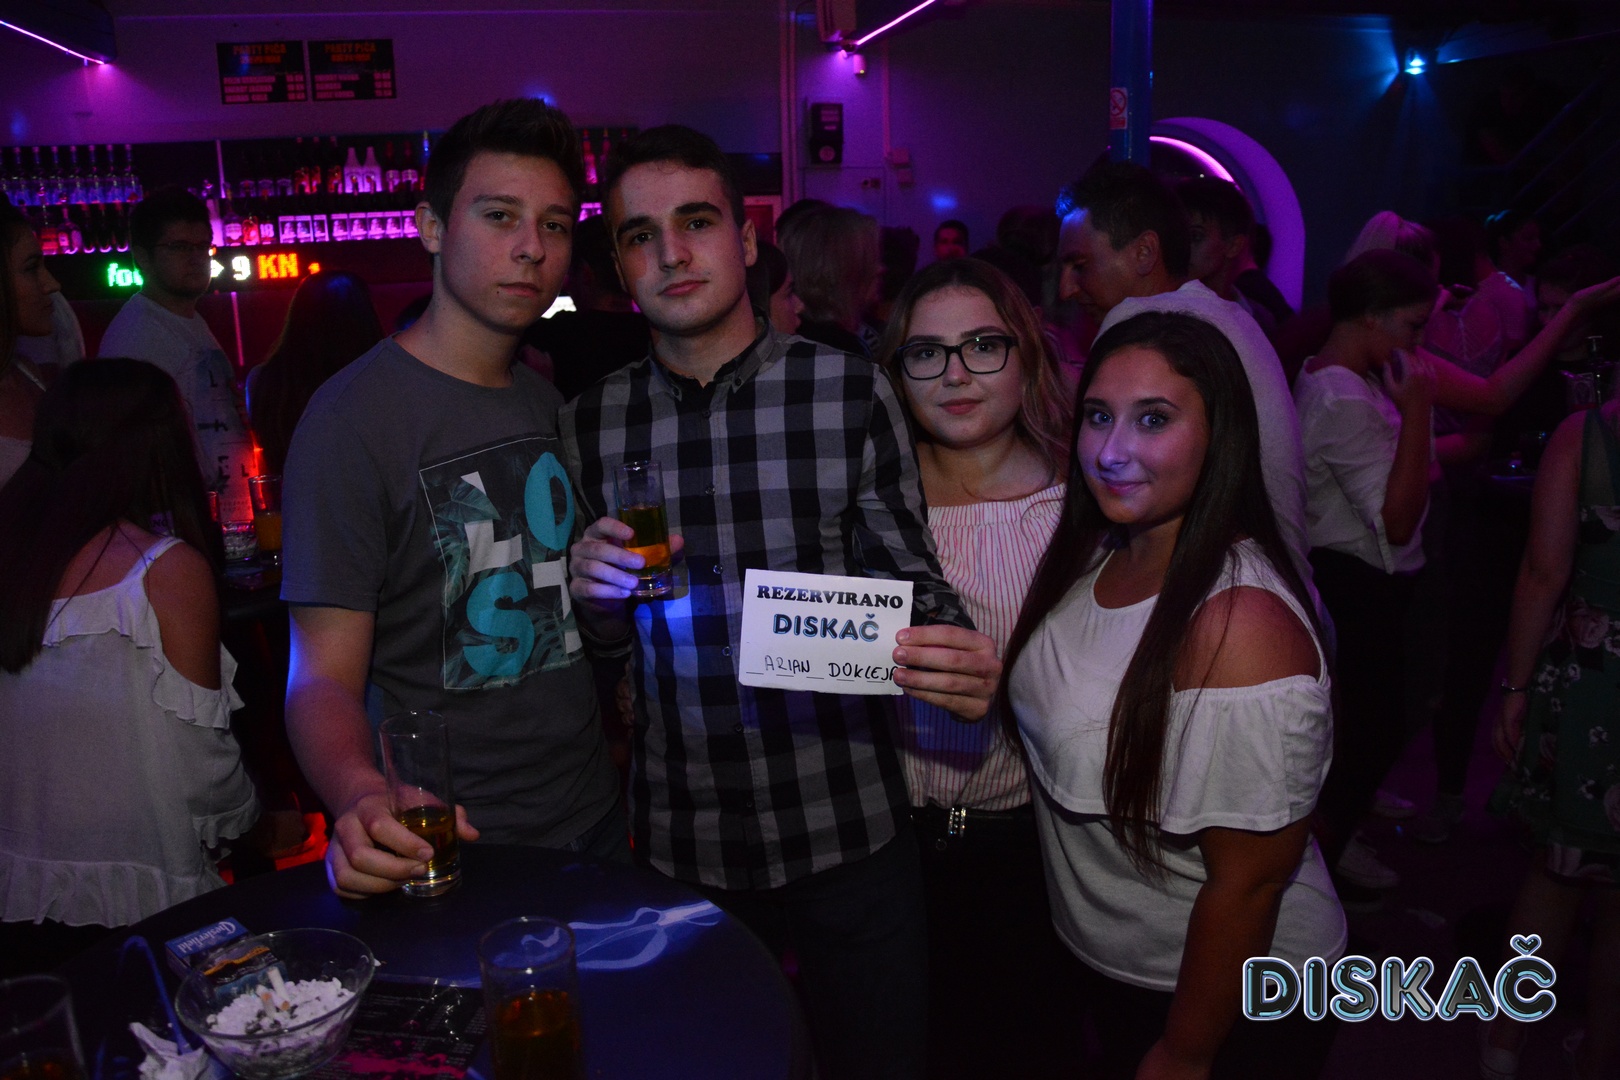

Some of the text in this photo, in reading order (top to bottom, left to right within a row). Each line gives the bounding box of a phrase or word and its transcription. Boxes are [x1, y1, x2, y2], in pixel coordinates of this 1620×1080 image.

[231, 255, 252, 280] 9
[257, 253, 299, 279] KN
[756, 585, 904, 609] REZERVIRANO
[773, 613, 879, 642] DISKAČ
[764, 654, 811, 675] ARIAN
[176, 920, 236, 954] Chesterfield
